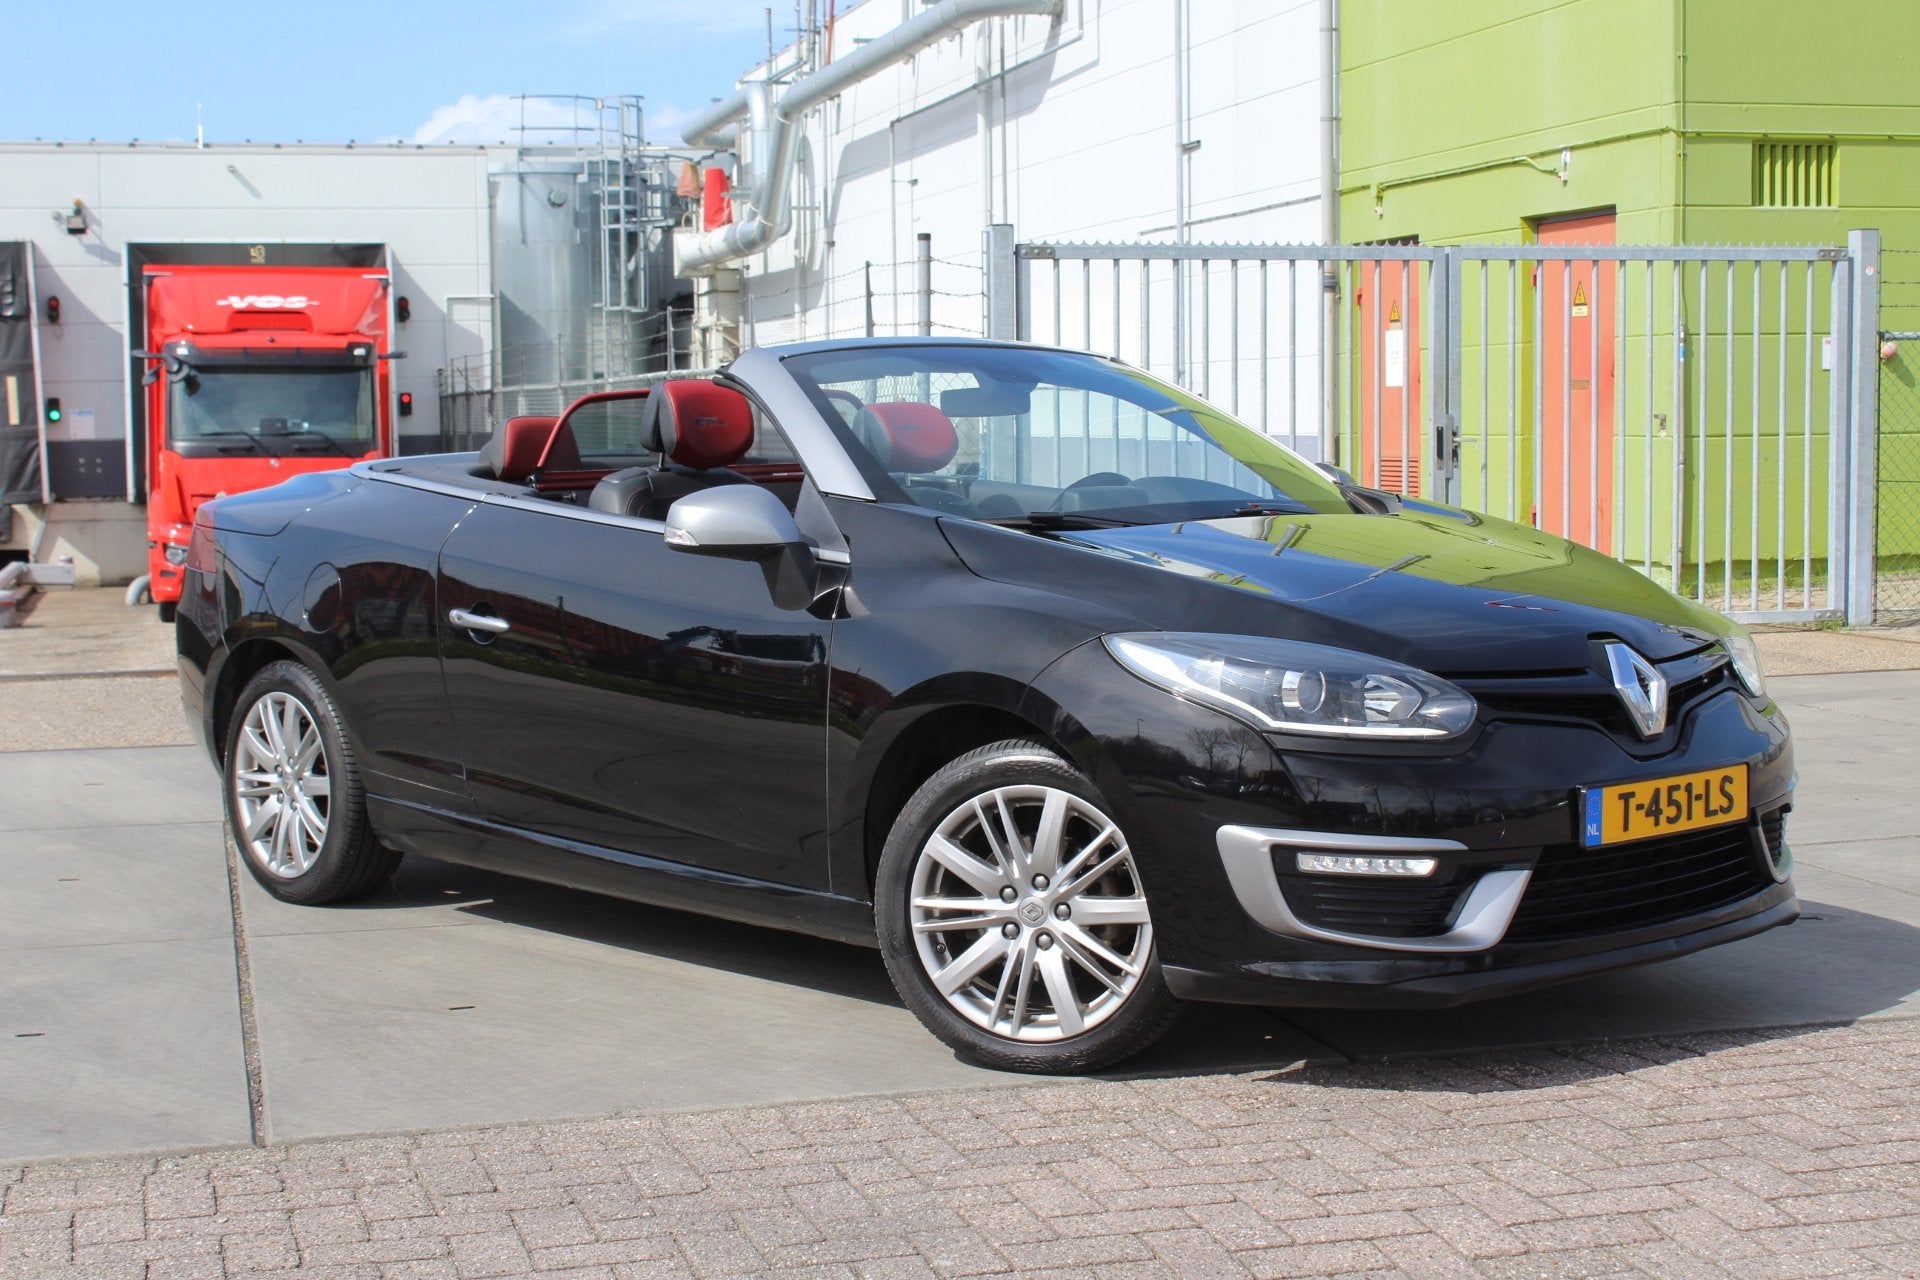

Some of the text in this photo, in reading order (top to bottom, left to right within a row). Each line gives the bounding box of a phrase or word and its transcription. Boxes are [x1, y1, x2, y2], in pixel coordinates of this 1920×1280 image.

[225, 294, 310, 309] VOS
[1617, 775, 1734, 833] T-451-LS
[1587, 823, 1600, 836] NL
